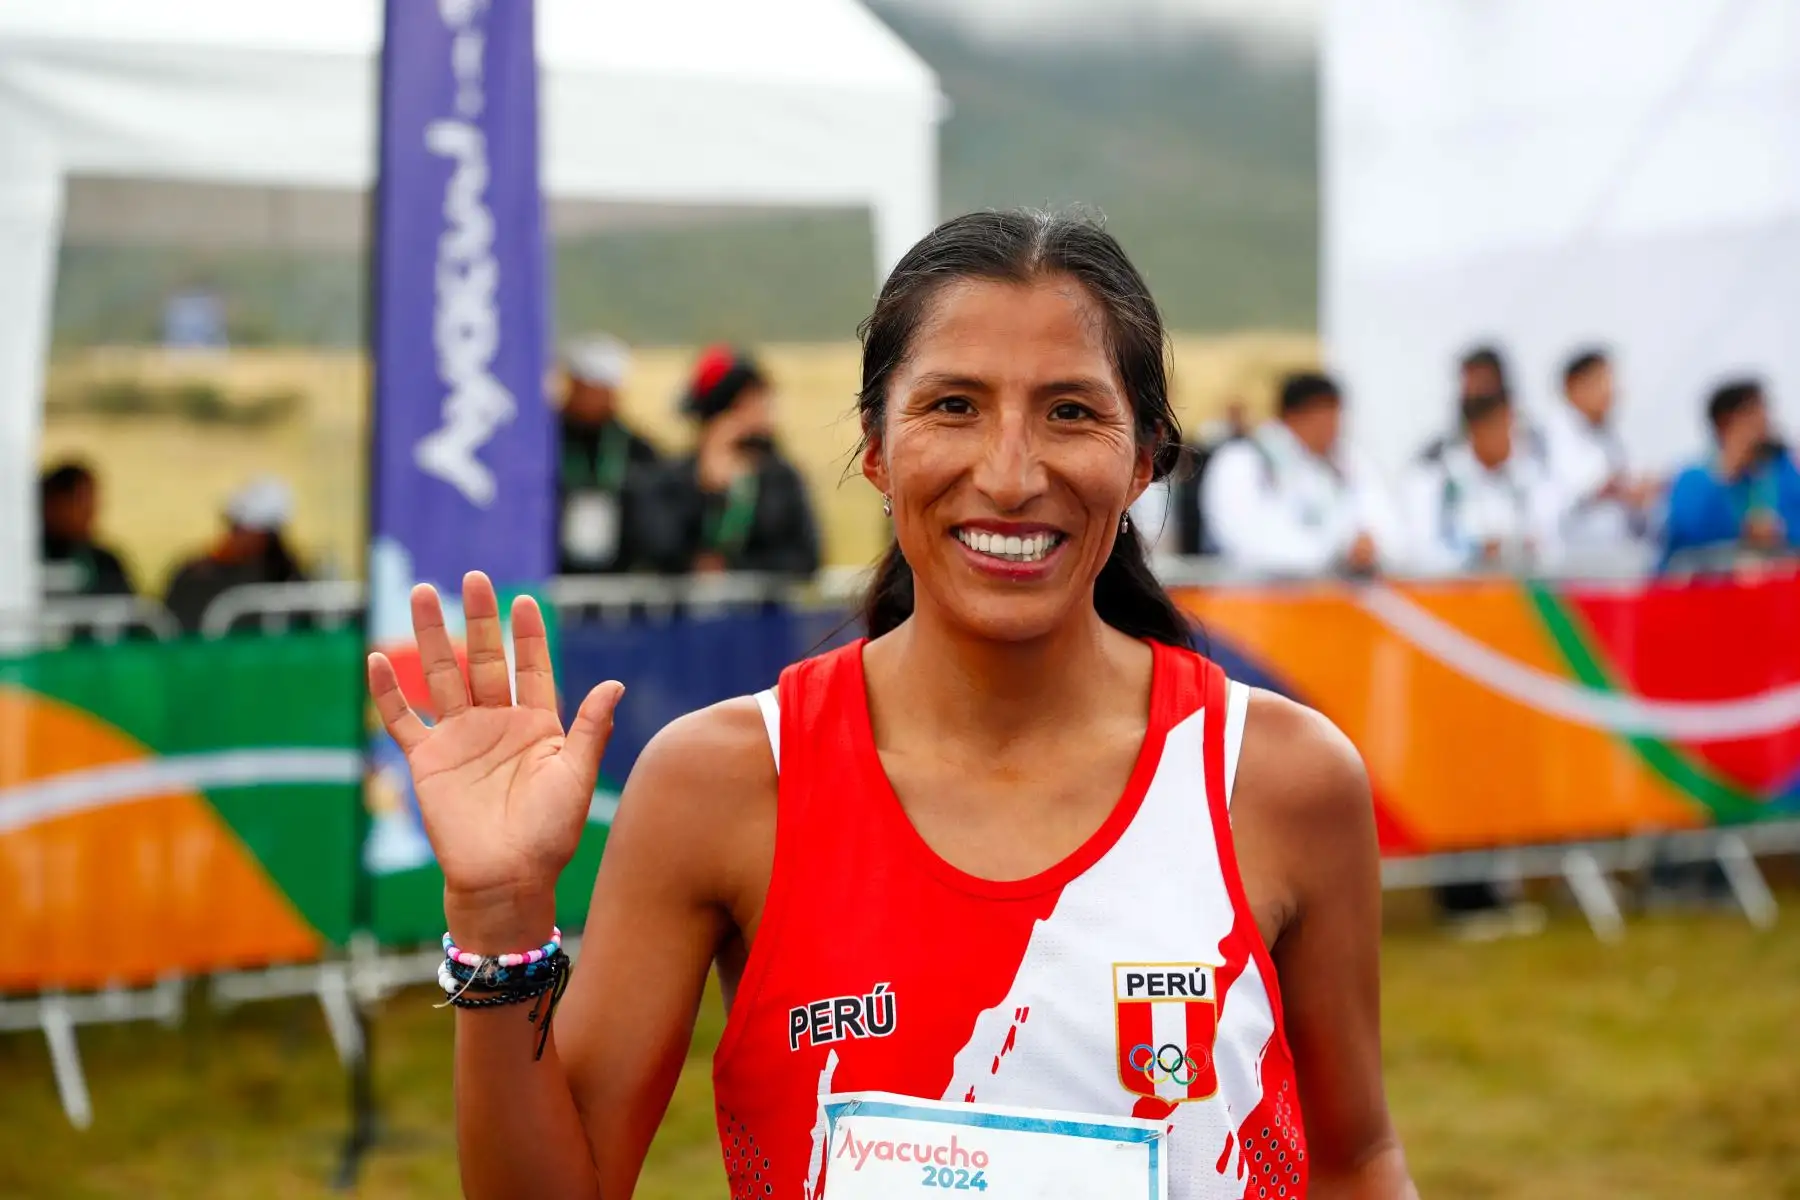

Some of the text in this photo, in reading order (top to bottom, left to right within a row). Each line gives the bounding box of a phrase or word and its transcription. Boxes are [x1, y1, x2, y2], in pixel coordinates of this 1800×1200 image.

[1126, 967, 1207, 997] PERÚ
[789, 982, 897, 1052] PERÚ
[836, 1128, 989, 1171] Ayacucho
[922, 1165, 988, 1191] 2024
